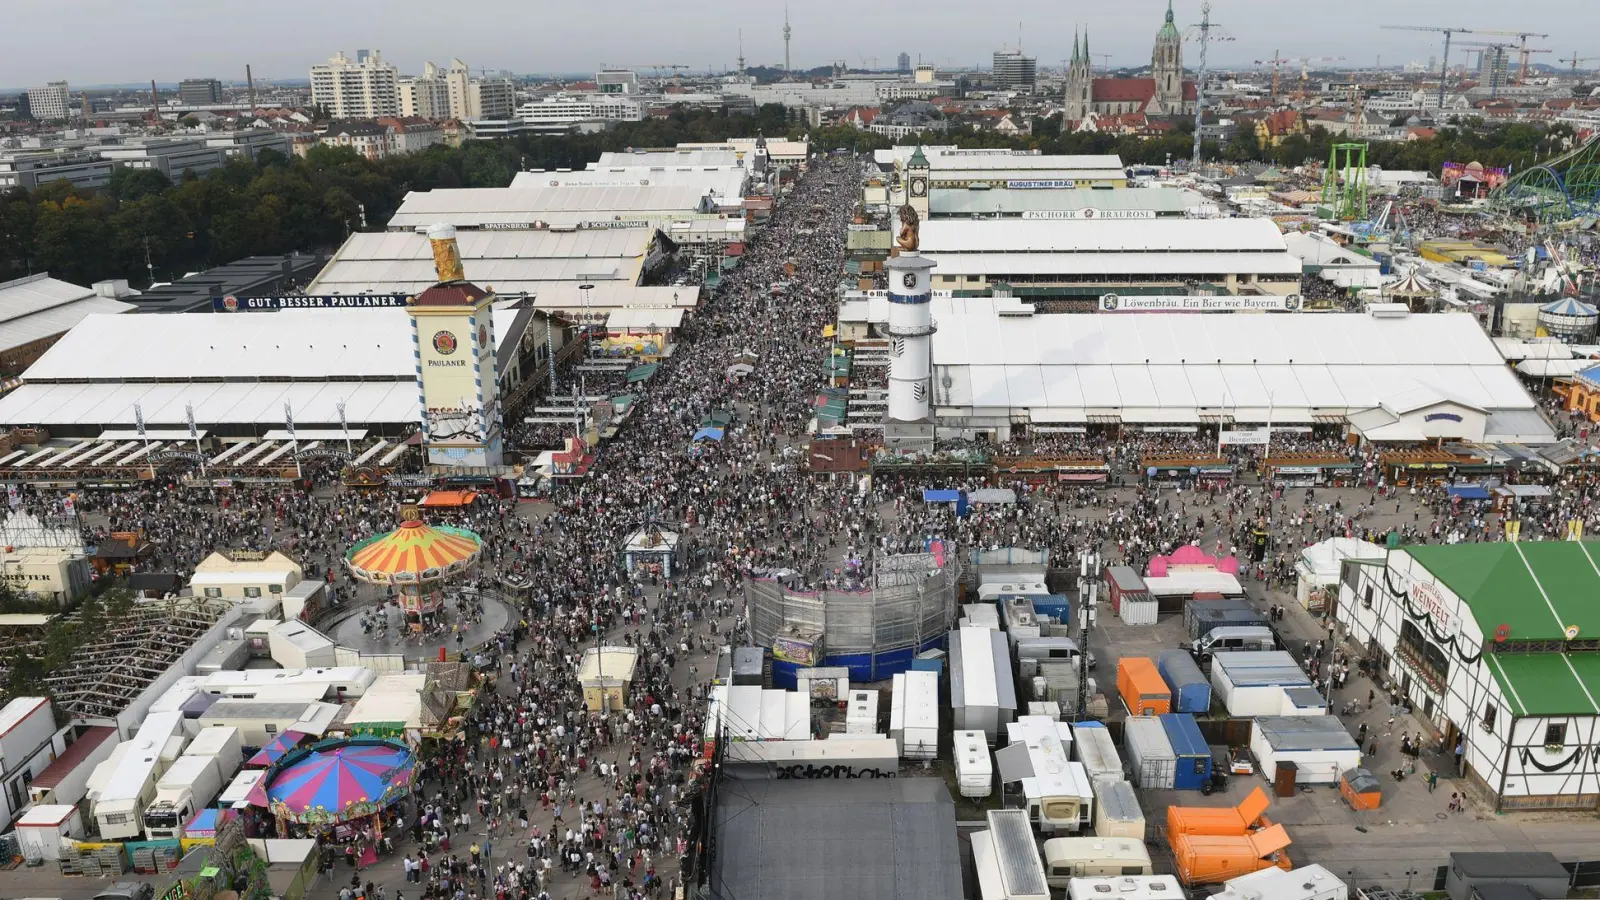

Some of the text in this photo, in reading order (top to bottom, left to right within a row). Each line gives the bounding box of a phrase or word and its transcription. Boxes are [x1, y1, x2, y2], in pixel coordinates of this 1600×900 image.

[1100, 210, 1151, 218] BRÄUROSL
[248, 296, 402, 308] GUT, BESSER, PAULANER.
[1124, 298, 1280, 310] Löwenbräu. Ein Bier wie Bayern.
[146, 451, 206, 464] PAULANERGARTEN
[293, 449, 353, 462] PAULANERGARTEN
[1412, 583, 1451, 626] WEINZELT
